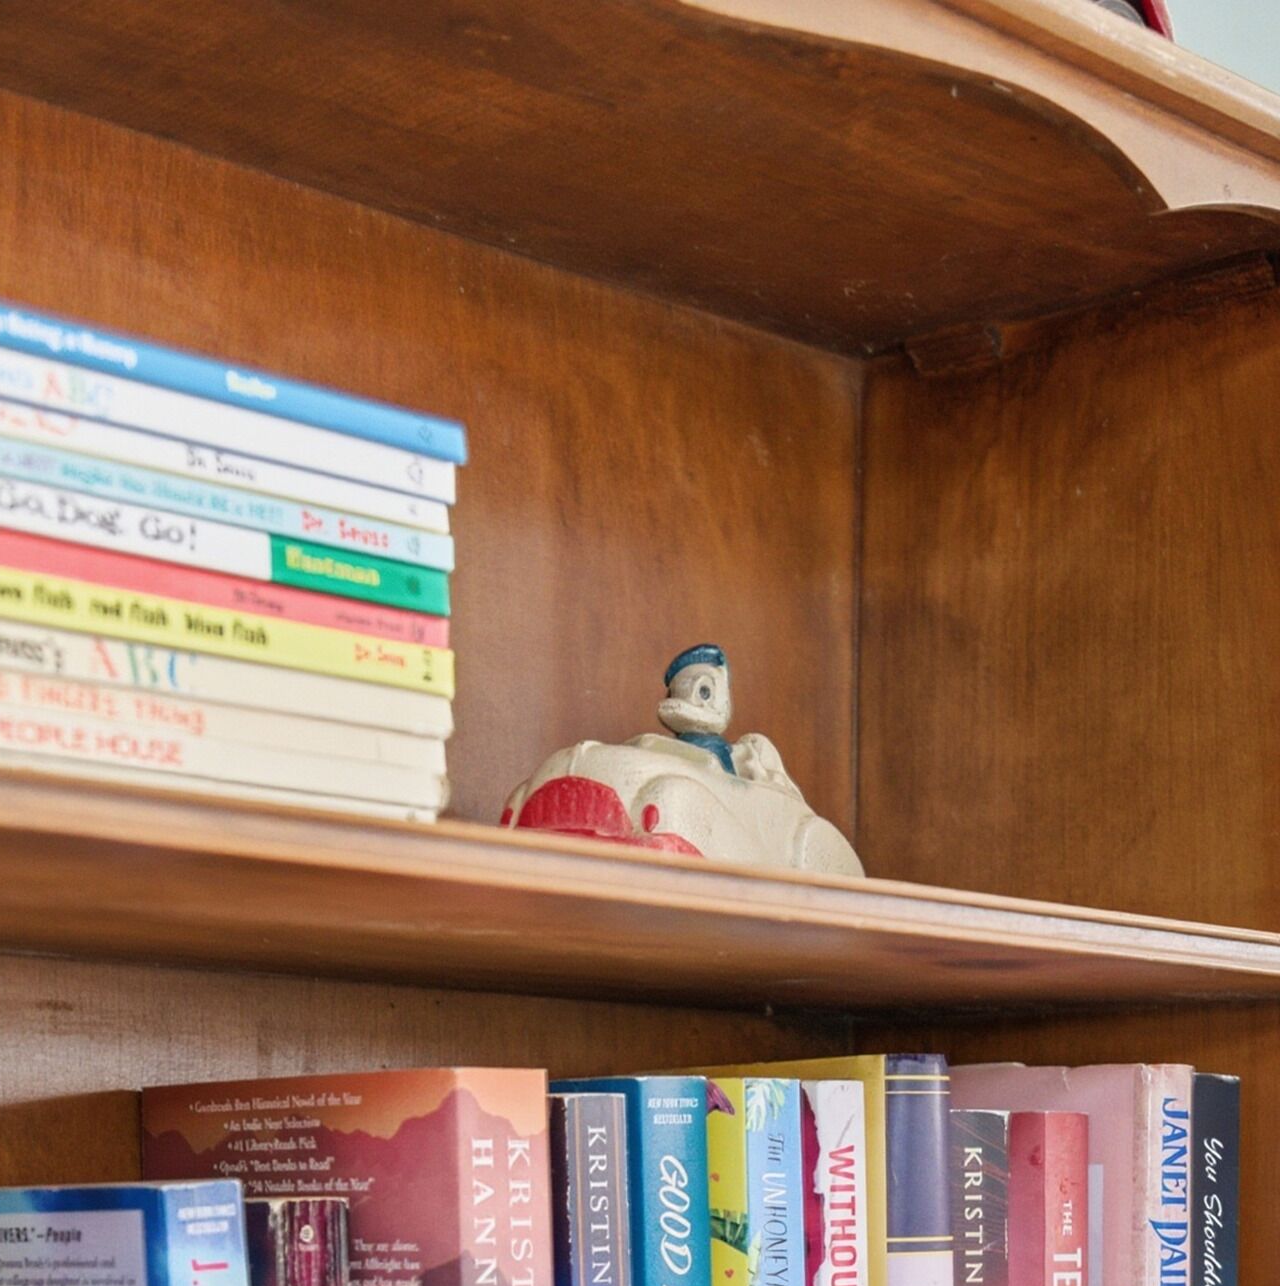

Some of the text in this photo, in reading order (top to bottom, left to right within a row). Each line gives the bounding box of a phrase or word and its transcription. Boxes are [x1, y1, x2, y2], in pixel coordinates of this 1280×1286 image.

[138, 513, 198, 552] Go!
[129, 597, 169, 627] fish
[231, 617, 270, 647] fish
[93, 732, 185, 767] HOUSE
[1160, 1096, 1190, 1214] JANET
[1204, 1137, 1224, 1184] You
[587, 1124, 614, 1285] KRISTIN
[658, 1154, 693, 1276] GOOD
[963, 1146, 984, 1284] KRISTIN
[1061, 1199, 1074, 1237] THE
